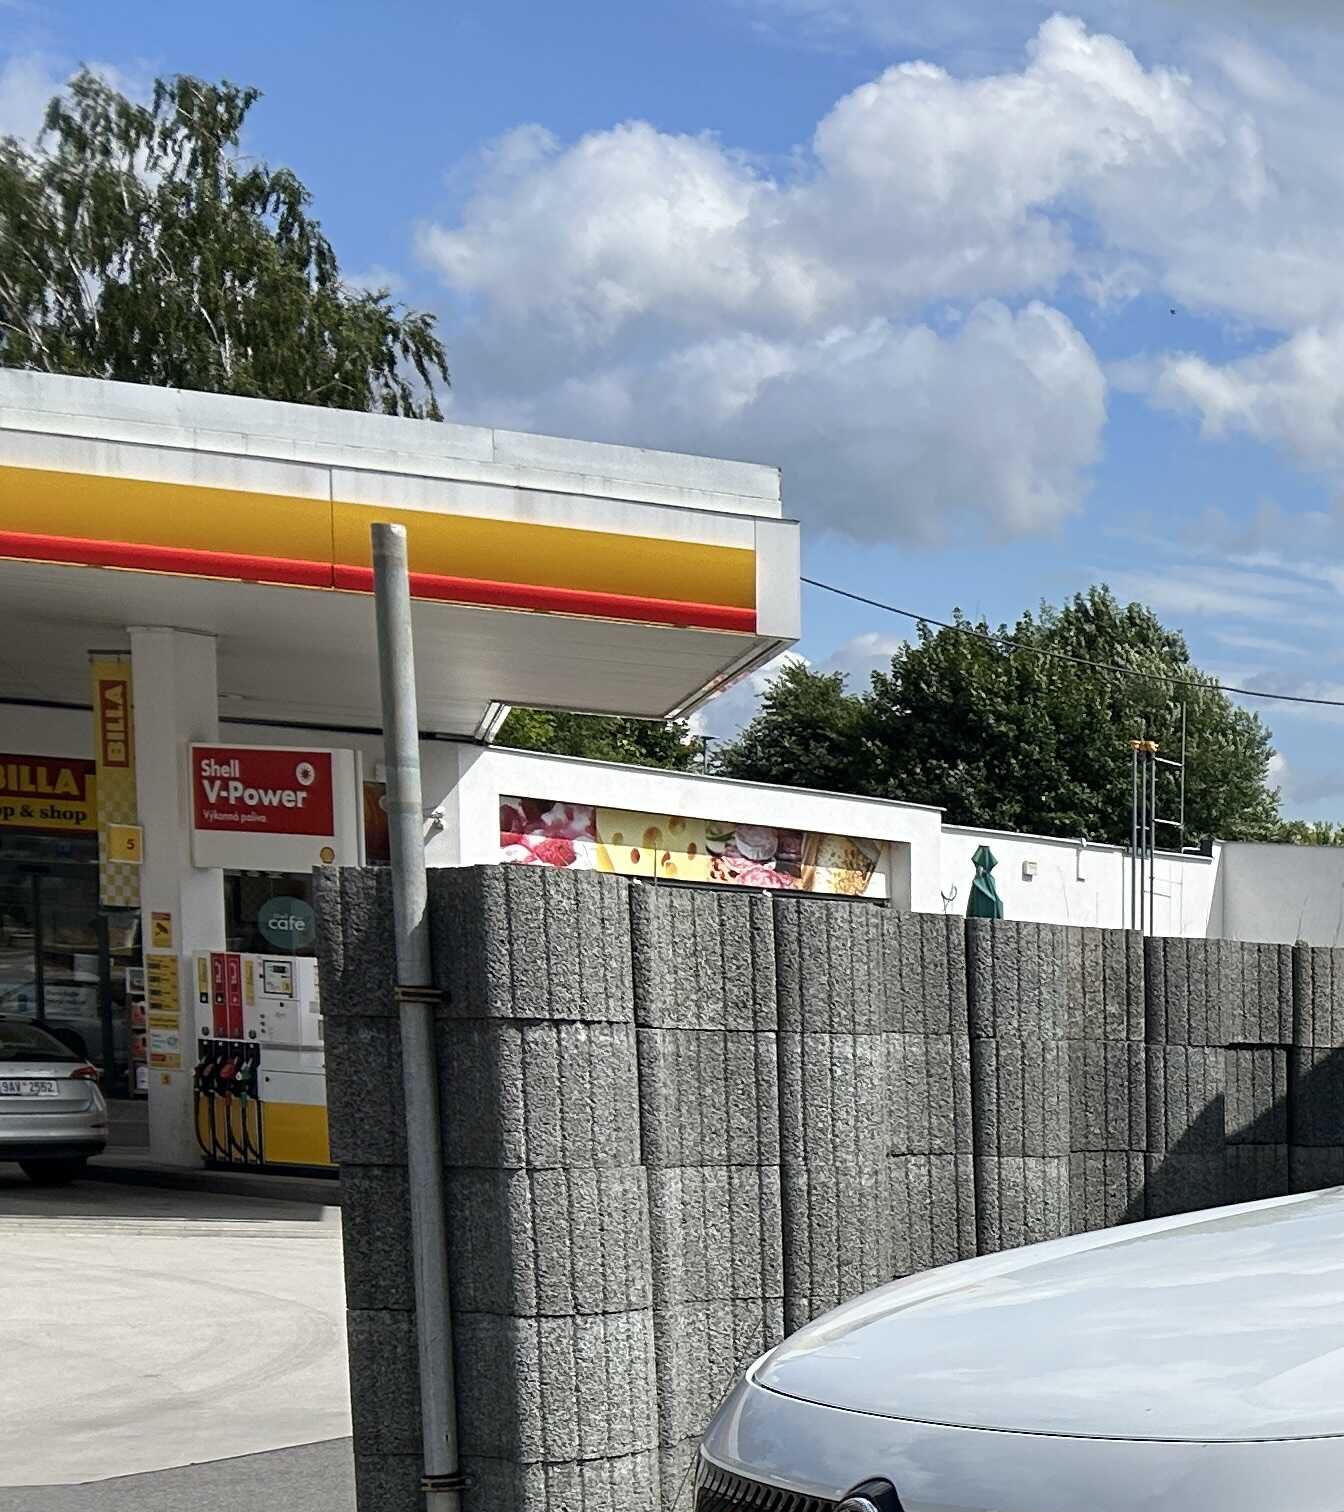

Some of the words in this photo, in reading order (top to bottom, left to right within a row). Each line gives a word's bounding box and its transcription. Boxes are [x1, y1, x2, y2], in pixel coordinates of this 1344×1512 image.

[104, 684, 126, 762] BILLA
[201, 758, 240, 778] Shell
[202, 779, 308, 808] V-Power
[19, 804, 34, 818] &
[40, 804, 87, 825] shop
[126, 838, 136, 850] 5
